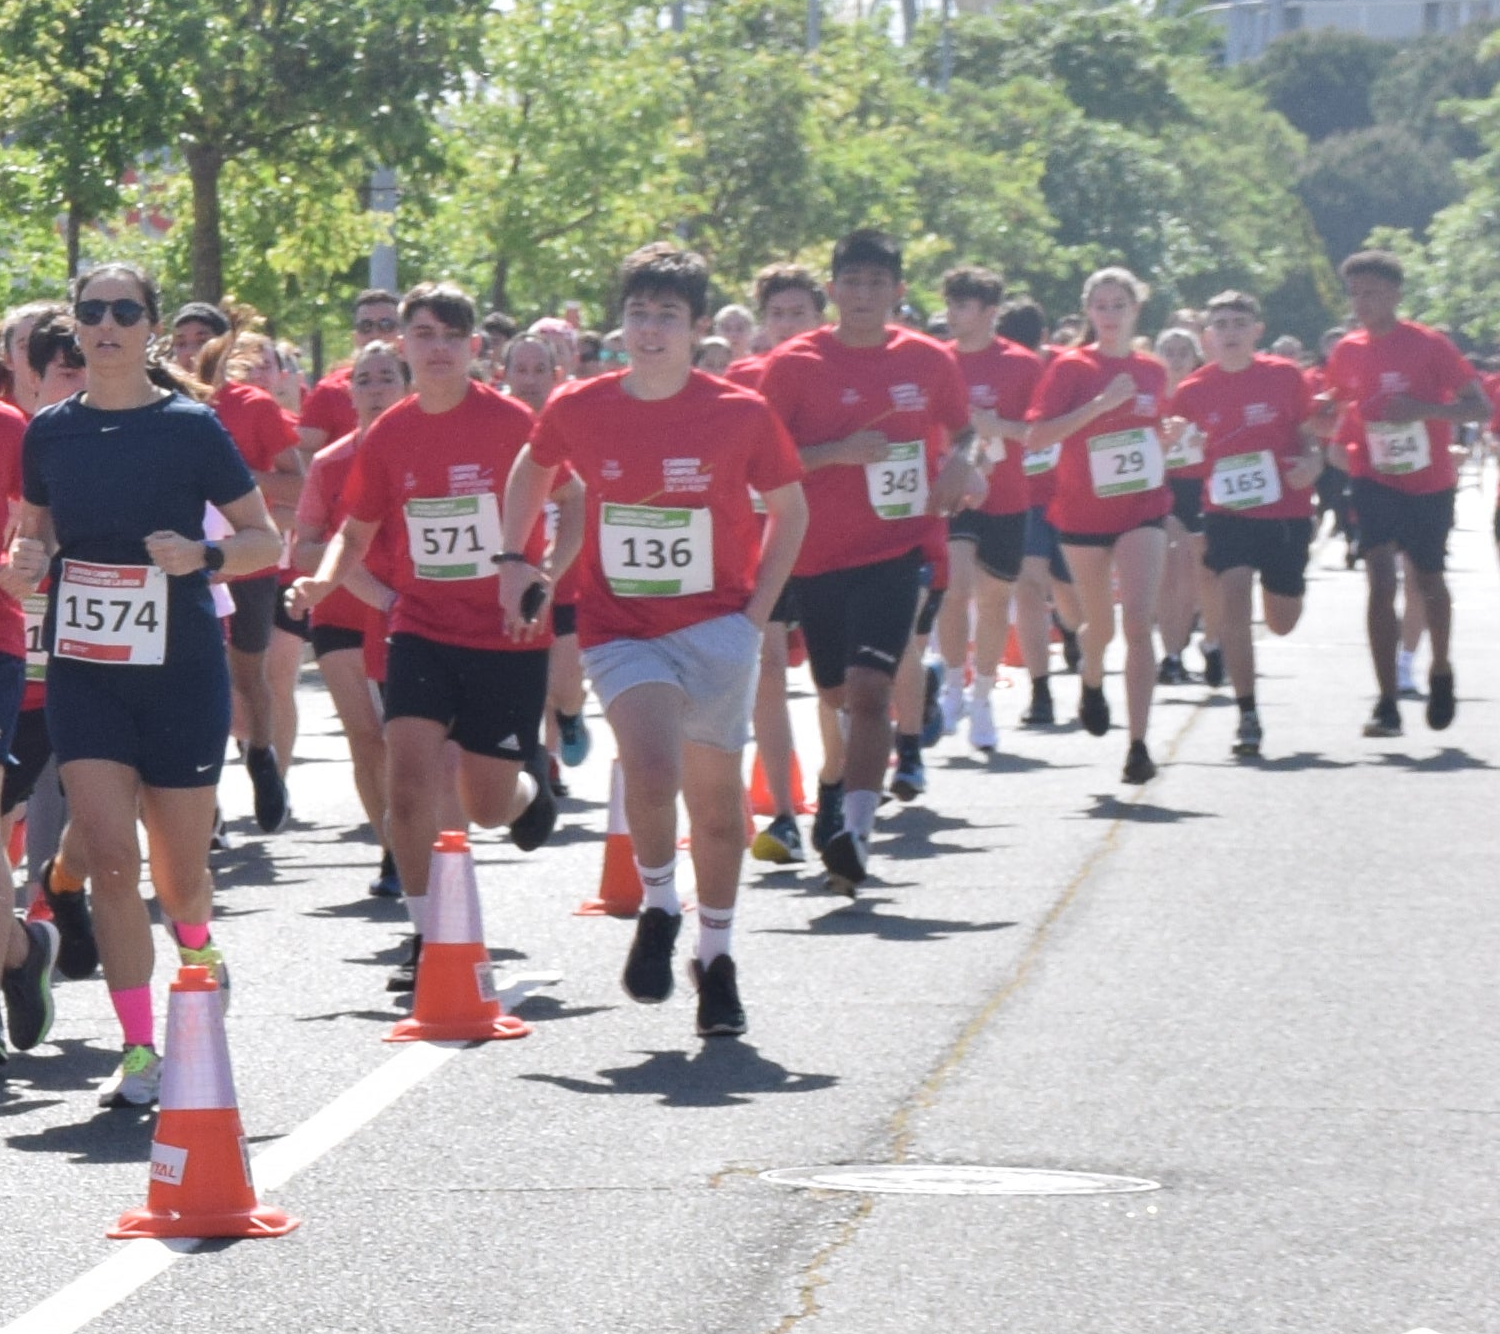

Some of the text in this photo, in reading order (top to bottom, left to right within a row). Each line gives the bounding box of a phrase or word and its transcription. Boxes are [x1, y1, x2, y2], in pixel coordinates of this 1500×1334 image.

[1113, 450, 1144, 475] 29
[422, 524, 485, 555] 571
[622, 537, 692, 569] 136
[65, 595, 158, 633] 1574
